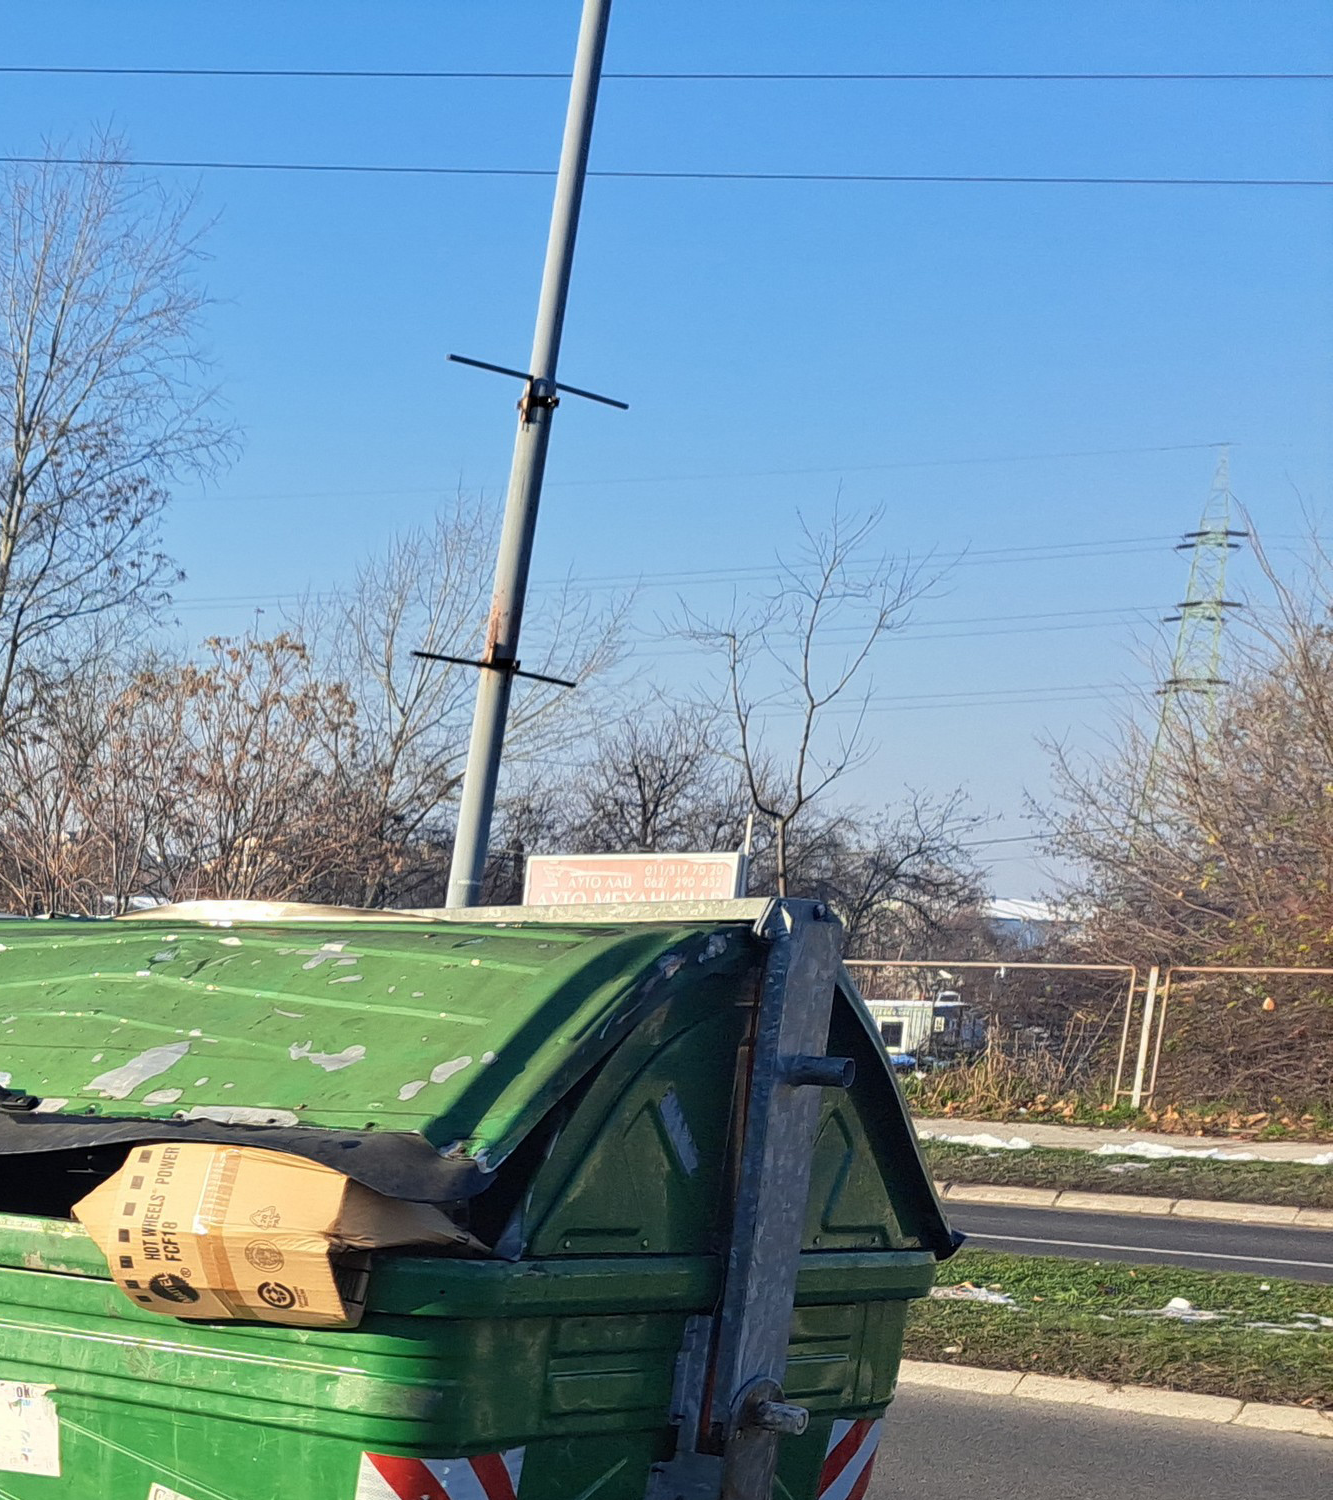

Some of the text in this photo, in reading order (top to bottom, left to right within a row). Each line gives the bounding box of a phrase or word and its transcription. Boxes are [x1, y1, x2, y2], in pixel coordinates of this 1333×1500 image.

[142, 1147, 180, 1261] HOT WHEELS POWER
[162, 1221, 182, 1262] FCF18
